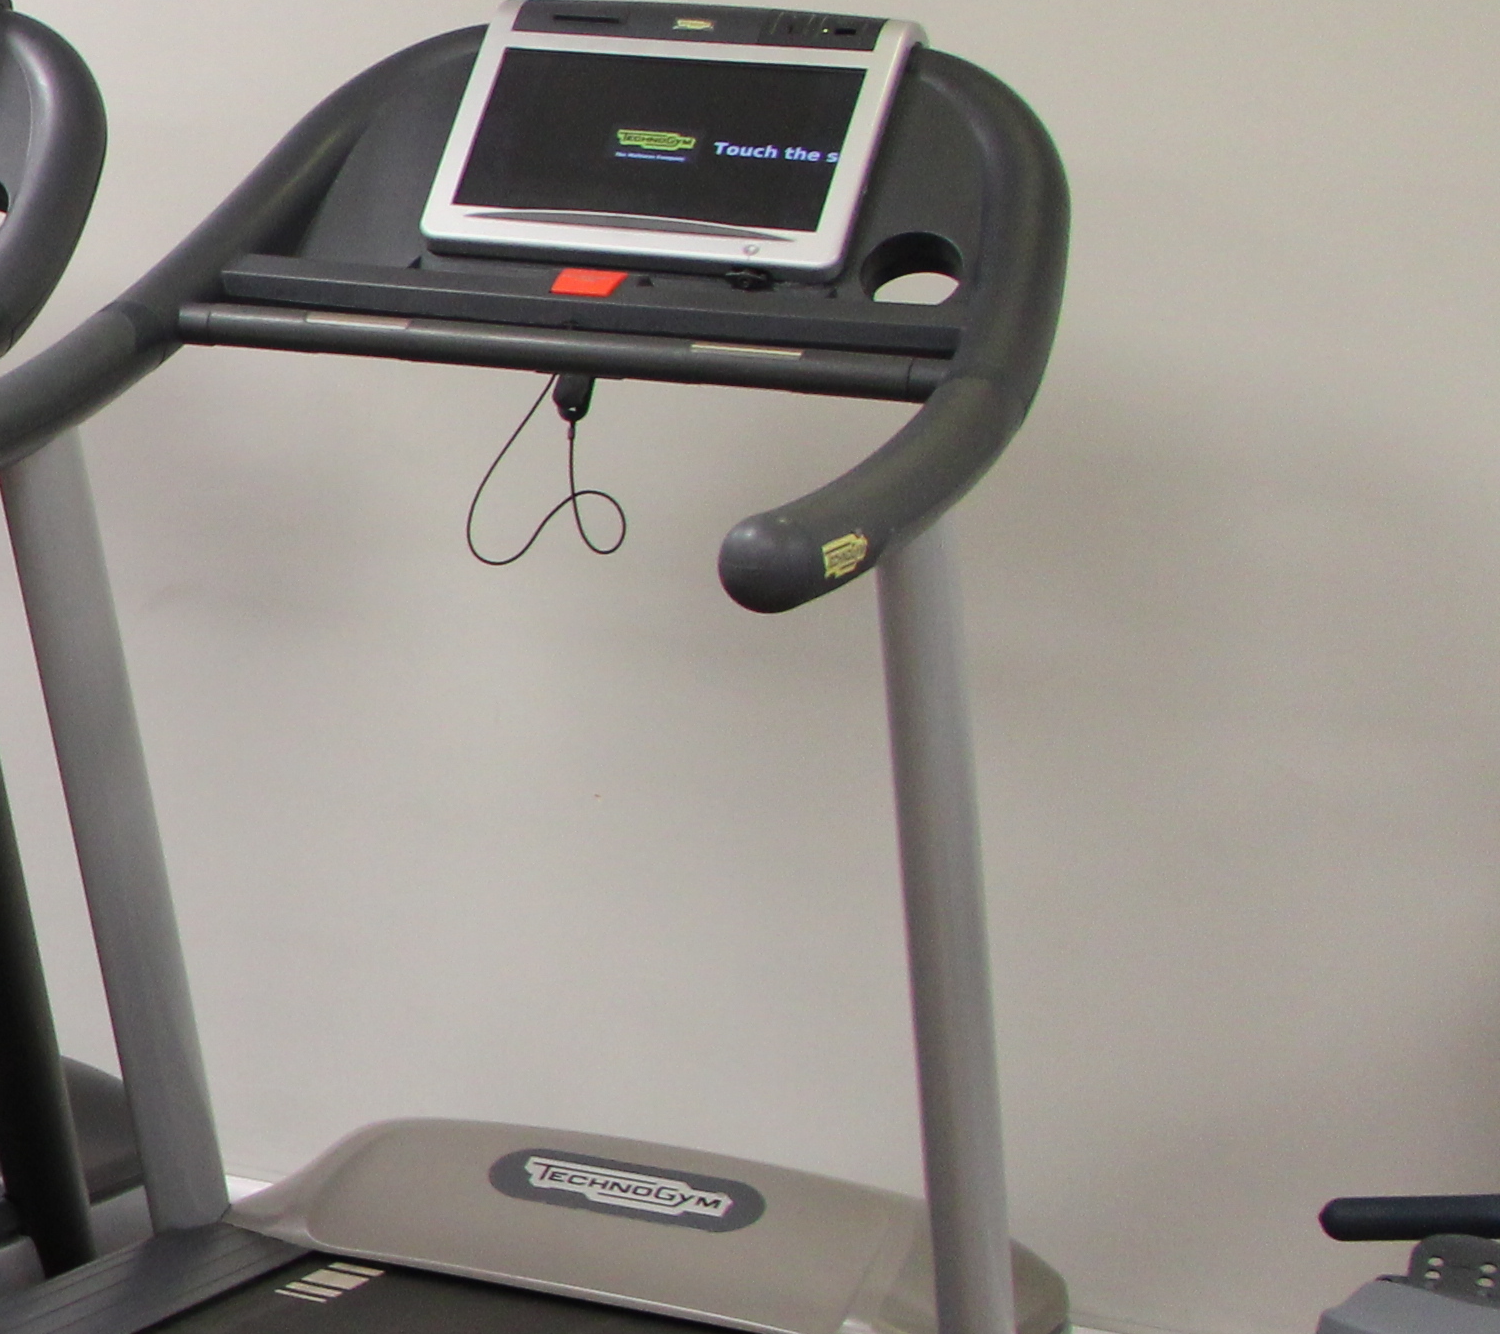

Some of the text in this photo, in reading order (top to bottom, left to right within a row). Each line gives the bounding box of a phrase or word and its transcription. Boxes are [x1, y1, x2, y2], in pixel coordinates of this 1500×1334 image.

[714, 141, 778, 159] Touch
[785, 146, 821, 162] the
[533, 1162, 722, 1209] TECHNOGYM
